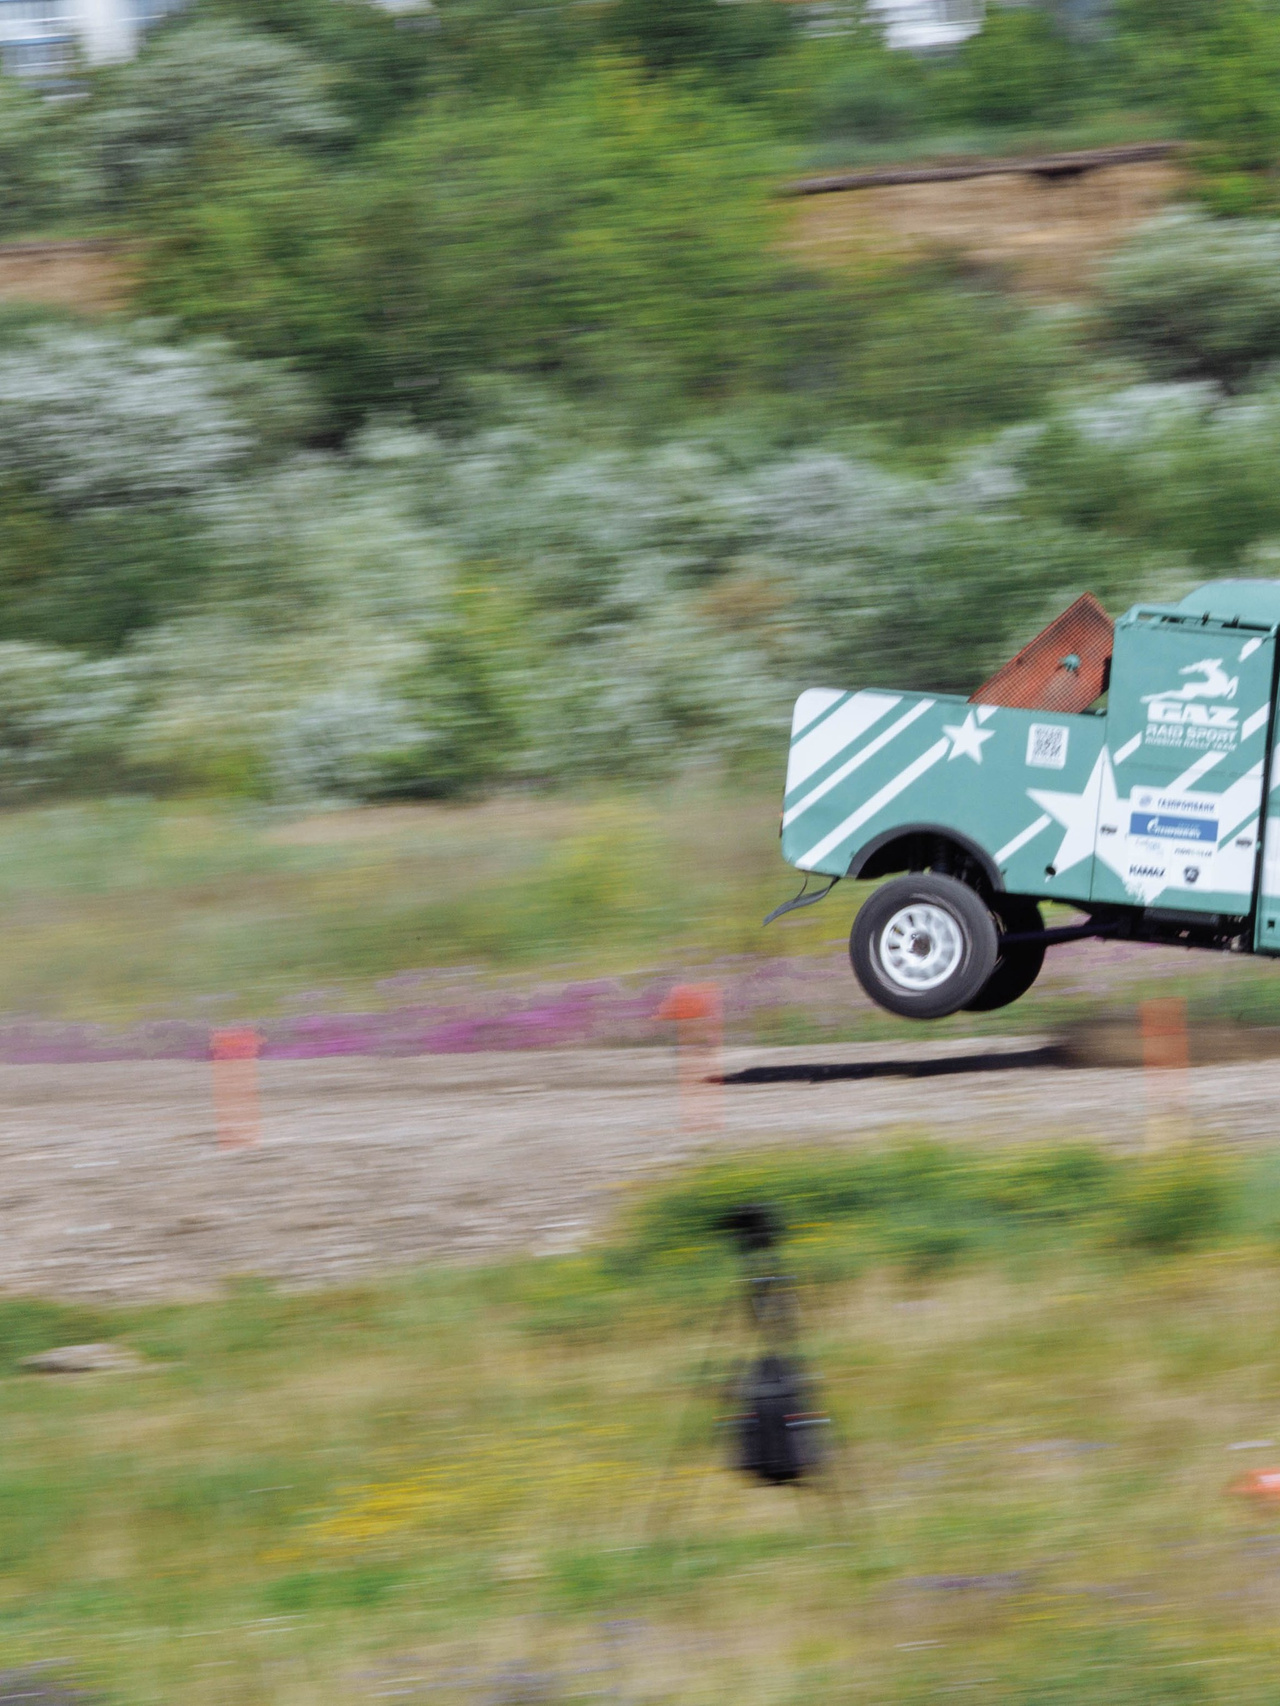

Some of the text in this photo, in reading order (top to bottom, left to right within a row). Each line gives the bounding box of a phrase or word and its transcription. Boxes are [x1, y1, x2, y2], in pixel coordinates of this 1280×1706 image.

[1147, 701, 1239, 729] GAZ
[1146, 723, 1238, 743] RAID SPORT
